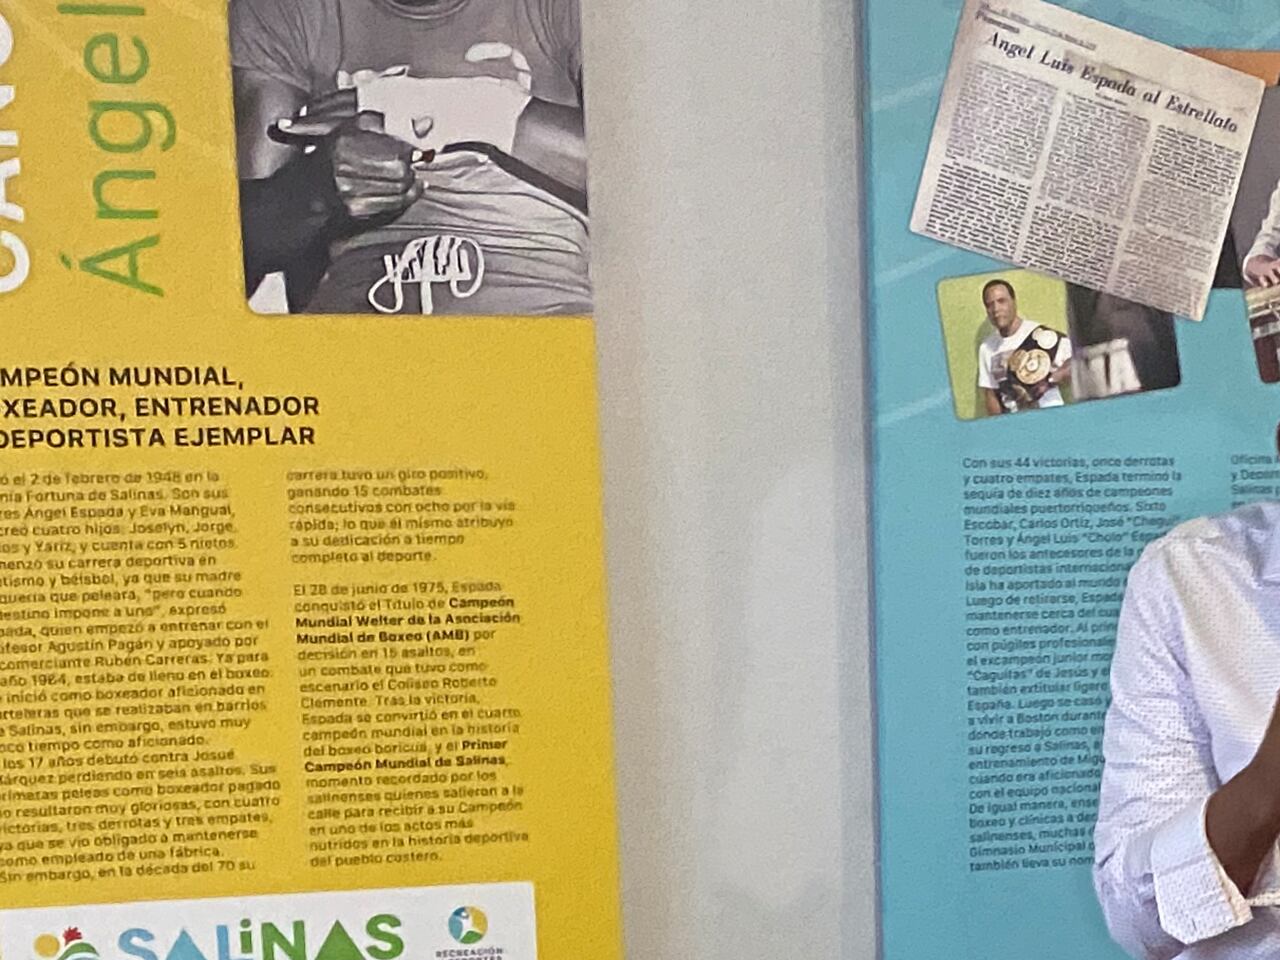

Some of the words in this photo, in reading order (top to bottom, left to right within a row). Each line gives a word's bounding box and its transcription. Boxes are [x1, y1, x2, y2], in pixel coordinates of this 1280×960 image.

[985, 32, 1036, 60] Angel
[1040, 49, 1075, 76] Luis
[1080, 66, 1138, 100] Espada
[1142, 90, 1162, 106] al
[1166, 94, 1239, 134] Estrellato
[56, 3, 178, 298] Ángel
[108, 366, 244, 390] MUNDIAL,
[135, 396, 319, 417] ENTRENADOR
[174, 427, 315, 447] EJEMPLAR
[962, 456, 987, 468] Con
[990, 458, 1011, 468] sus
[1013, 455, 1030, 468] 44
[1032, 455, 1089, 470] victorias,
[1092, 457, 1121, 467] once
[1123, 454, 1175, 467] derrotas
[972, 471, 1013, 484] cuatro
[1016, 470, 1072, 486] empates,
[1075, 470, 1119, 486] Espada
[1121, 469, 1169, 482] terminó
[26, 489, 83, 502] Fortuna
[88, 488, 106, 501] de
[171, 486, 199, 499] Son
[202, 488, 228, 498] sus
[287, 484, 349, 500] ganando
[354, 484, 368, 496] 15
[372, 483, 441, 496] combates
[24, 504, 66, 522] Ángel
[70, 505, 123, 521] Espada
[140, 504, 165, 517] Eva
[963, 517, 1017, 532] Escobar,
[1018, 516, 1057, 529] Carlos
[1060, 515, 1093, 531] Ortiz,
[1095, 515, 1124, 528] José
[964, 532, 1003, 545] Torres
[1016, 529, 1050, 547] Ángel
[1053, 531, 1078, 544] Luis
[143, 572, 171, 586] que
[195, 568, 241, 582] madre
[293, 583, 305, 596] El
[351, 582, 388, 598] junio
[412, 580, 448, 596] 1975,
[451, 579, 501, 596] Espada
[295, 615, 352, 628] Mundial
[355, 613, 404, 627] Welter
[407, 613, 425, 626] de
[428, 613, 440, 625] la
[445, 611, 520, 625] Asociación
[296, 631, 353, 645] Mundial
[357, 630, 374, 643] de
[379, 629, 422, 642] Boxeo
[426, 628, 469, 644] (AMB)
[473, 630, 496, 643] por
[966, 625, 999, 636] como
[47, 638, 103, 655] Agustín
[107, 636, 152, 653] Pagán
[168, 634, 230, 651] apoyado
[234, 636, 257, 649] por
[320, 662, 381, 676] combate
[385, 664, 411, 678] que
[449, 662, 486, 673] como
[50, 690, 91, 702] como
[95, 685, 163, 700] boxeador
[167, 682, 244, 697] aficionado
[248, 684, 265, 694] en
[1016, 710, 1059, 724] Boston
[462, 737, 507, 751] Primer
[28, 755, 43, 768] 17
[48, 753, 83, 767] años
[86, 751, 138, 766] debutó
[142, 749, 189, 763] contra
[193, 747, 234, 762] Josué
[304, 758, 371, 776] Campeón
[375, 756, 431, 770] Mundial
[434, 755, 451, 768] de
[58, 768, 132, 786] perdiendo
[249, 762, 276, 775] Sus
[969, 842, 1025, 858] Gimnasio
[1028, 839, 1085, 858] Municipal
[41, 849, 113, 868] empleado
[334, 851, 382, 869] pueblo
[969, 857, 1019, 872] también
[25, 866, 95, 885] embargo,
[135, 861, 187, 876] década
[218, 859, 234, 872] 70
[435, 946, 504, 957] RECREACIÓN
